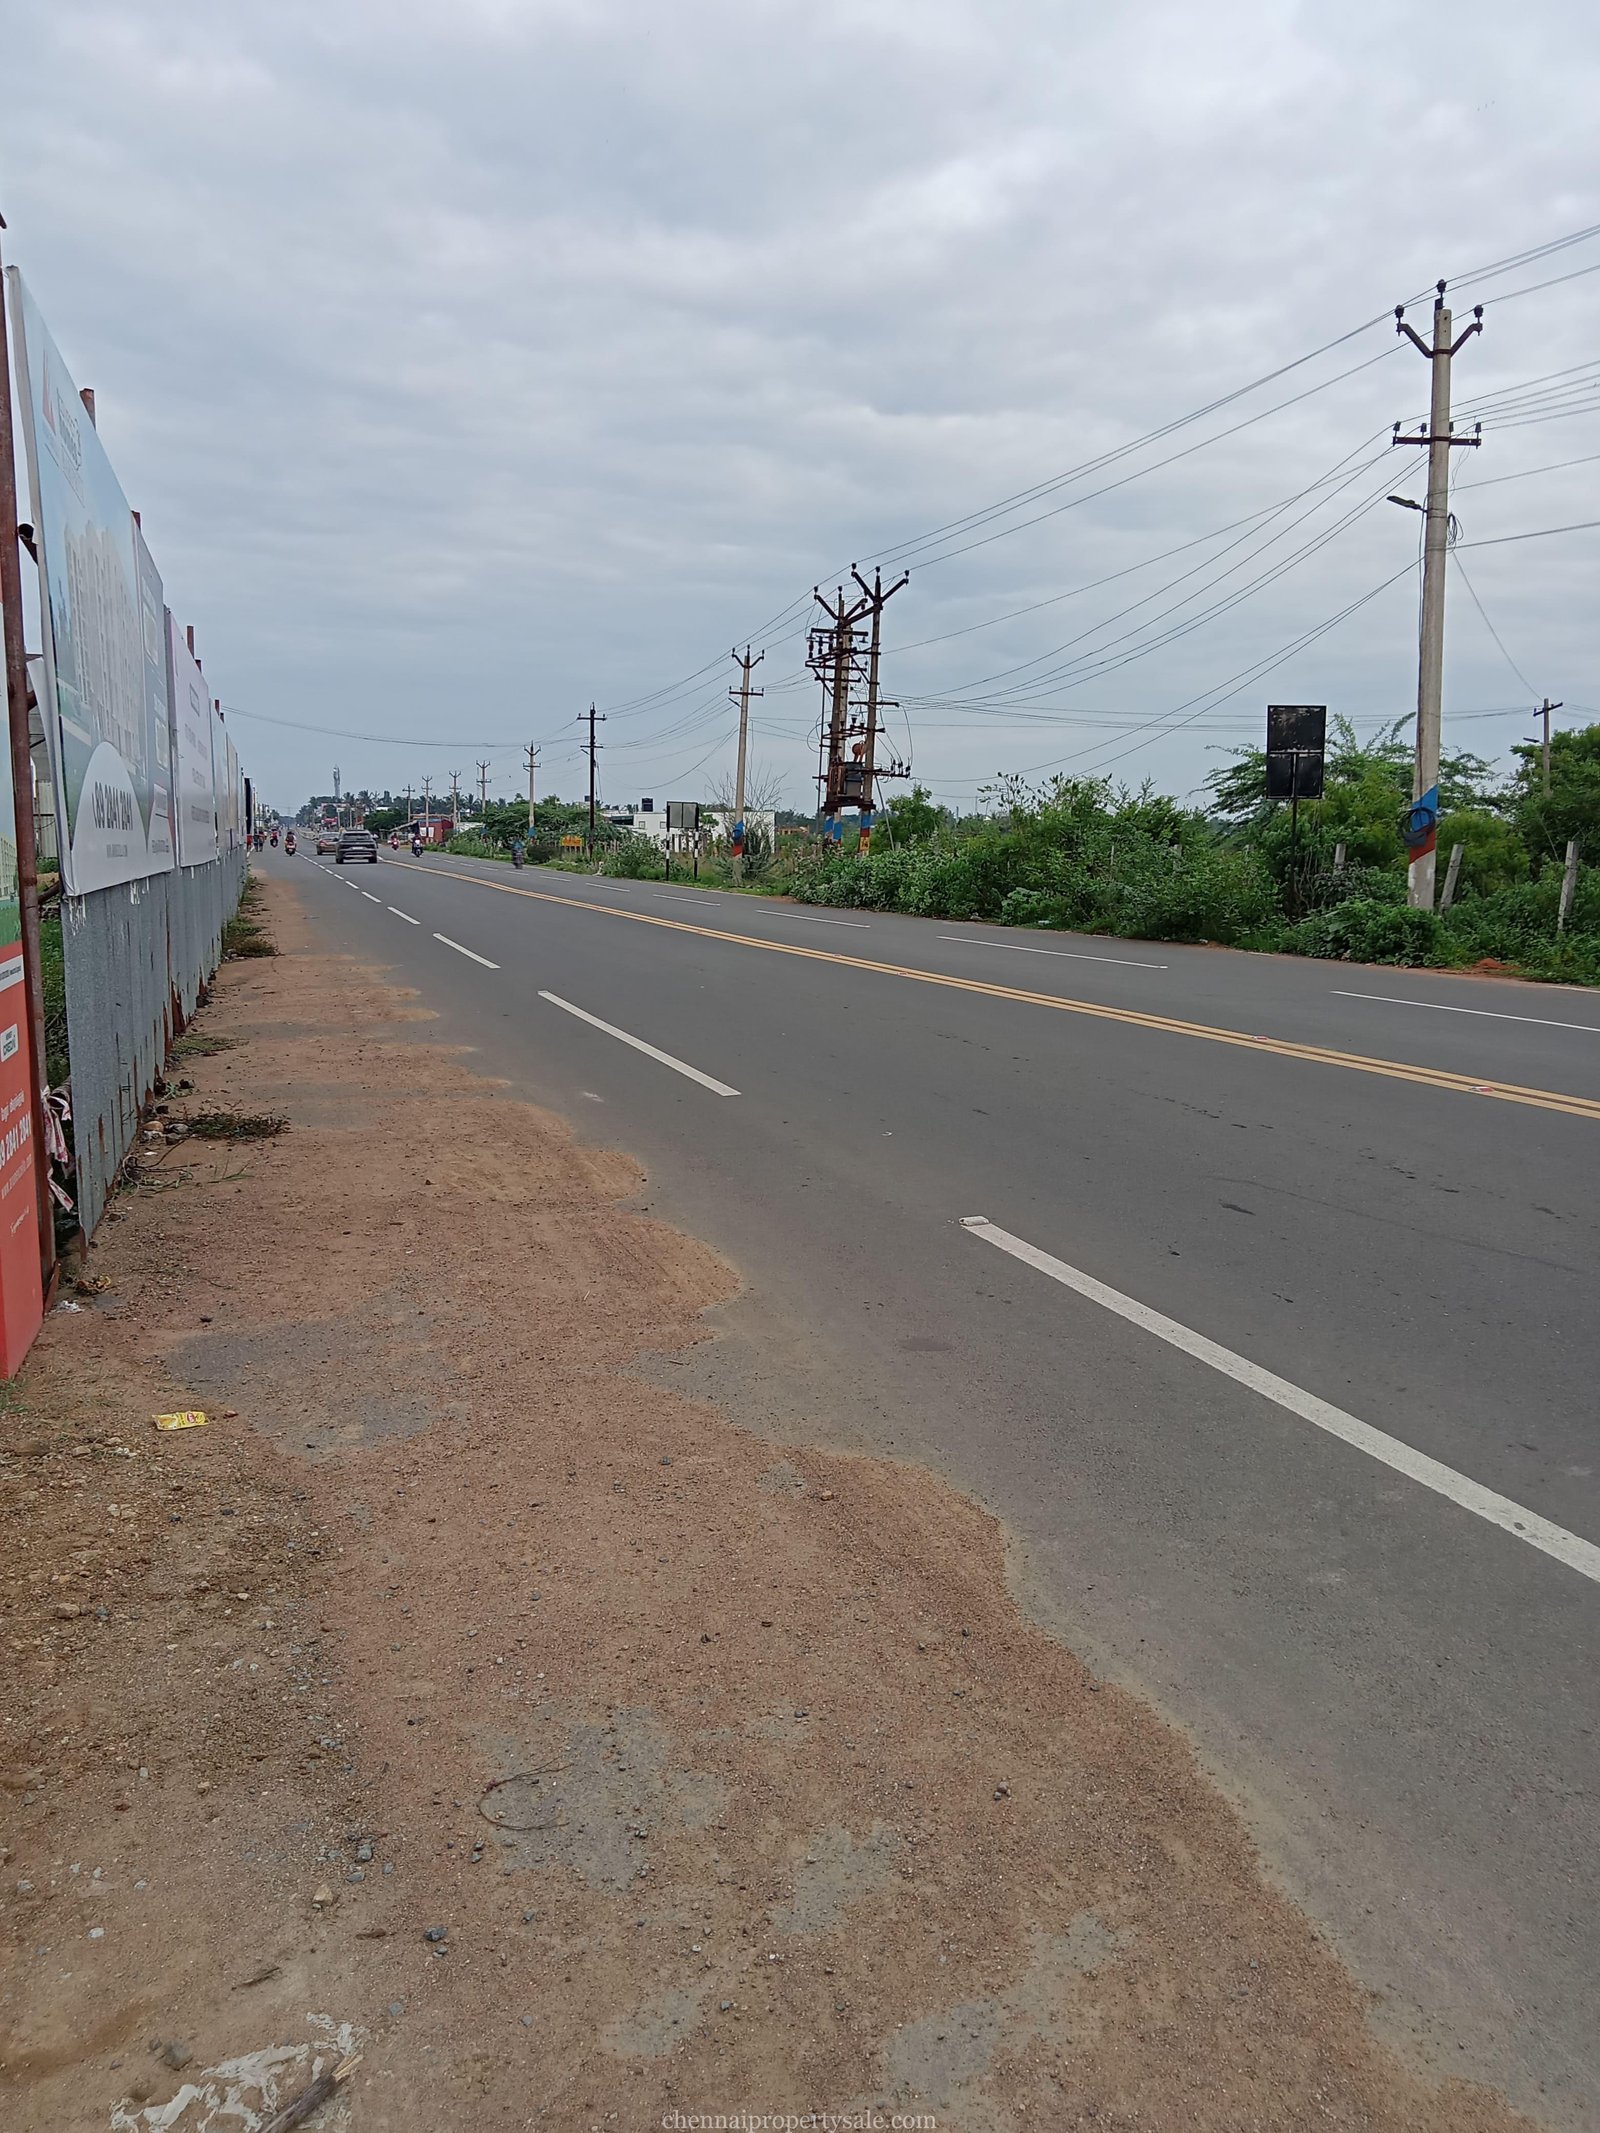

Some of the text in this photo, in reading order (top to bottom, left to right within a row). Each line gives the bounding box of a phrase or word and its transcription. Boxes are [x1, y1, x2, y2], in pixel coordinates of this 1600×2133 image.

[105, 784, 121, 830] 2841
[120, 790, 133, 831] 2841
[5, 1123, 20, 1161] 2841
[19, 1111, 32, 1145] 2841
